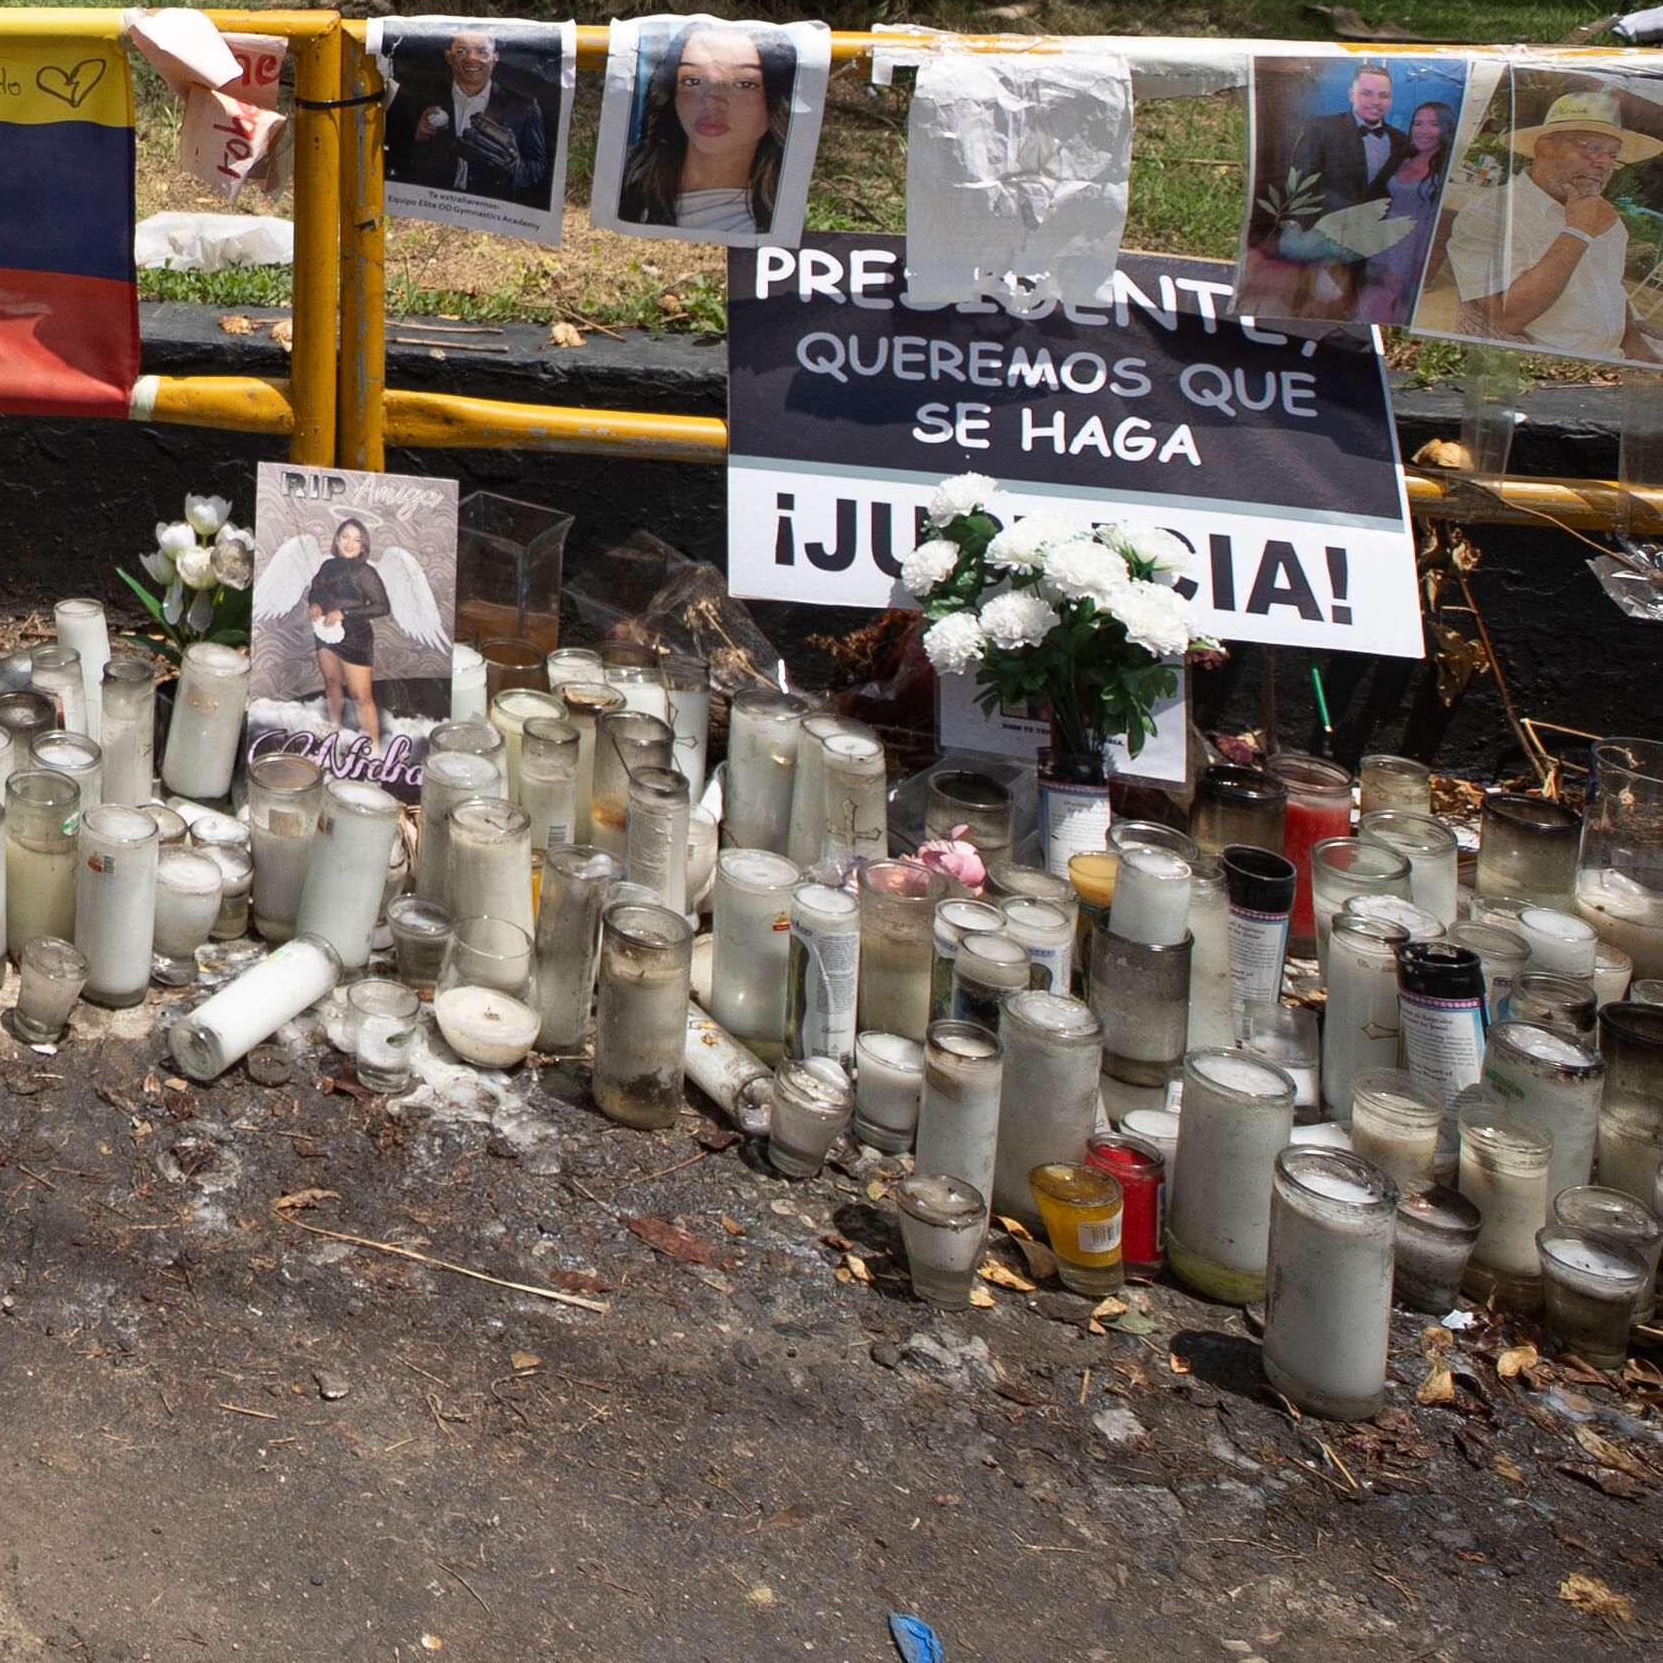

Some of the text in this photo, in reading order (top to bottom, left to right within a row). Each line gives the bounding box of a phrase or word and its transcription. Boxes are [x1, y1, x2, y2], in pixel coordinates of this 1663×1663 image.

[387, 195, 541, 231] Equipo Elite OD Gymnastics Academy
[428, 190, 439, 199] Te
[796, 331, 1318, 418] QUEREMOS QUE
[912, 402, 1201, 466] SE HAGA
[280, 471, 445, 522] RIP Amiga
